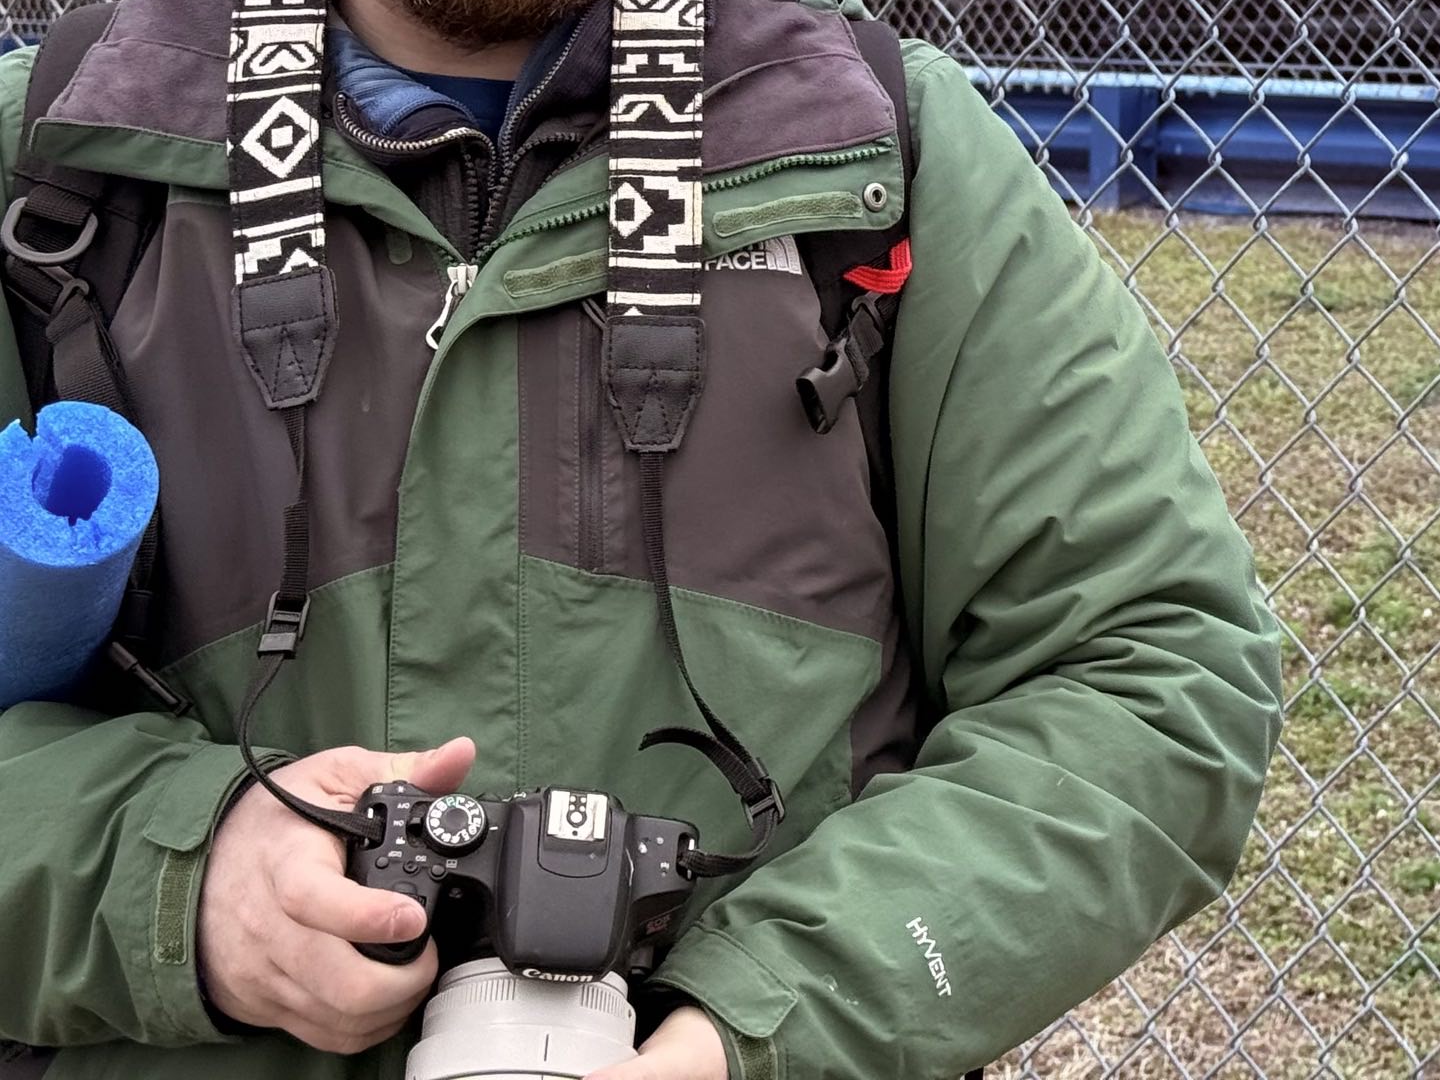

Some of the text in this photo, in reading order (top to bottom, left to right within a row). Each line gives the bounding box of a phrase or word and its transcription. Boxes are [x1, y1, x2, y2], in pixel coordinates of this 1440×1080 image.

[393, 819, 405, 827] ON
[415, 854, 428, 863] ISO
[906, 916, 952, 996] HYVENT
[522, 968, 594, 983] Canon
